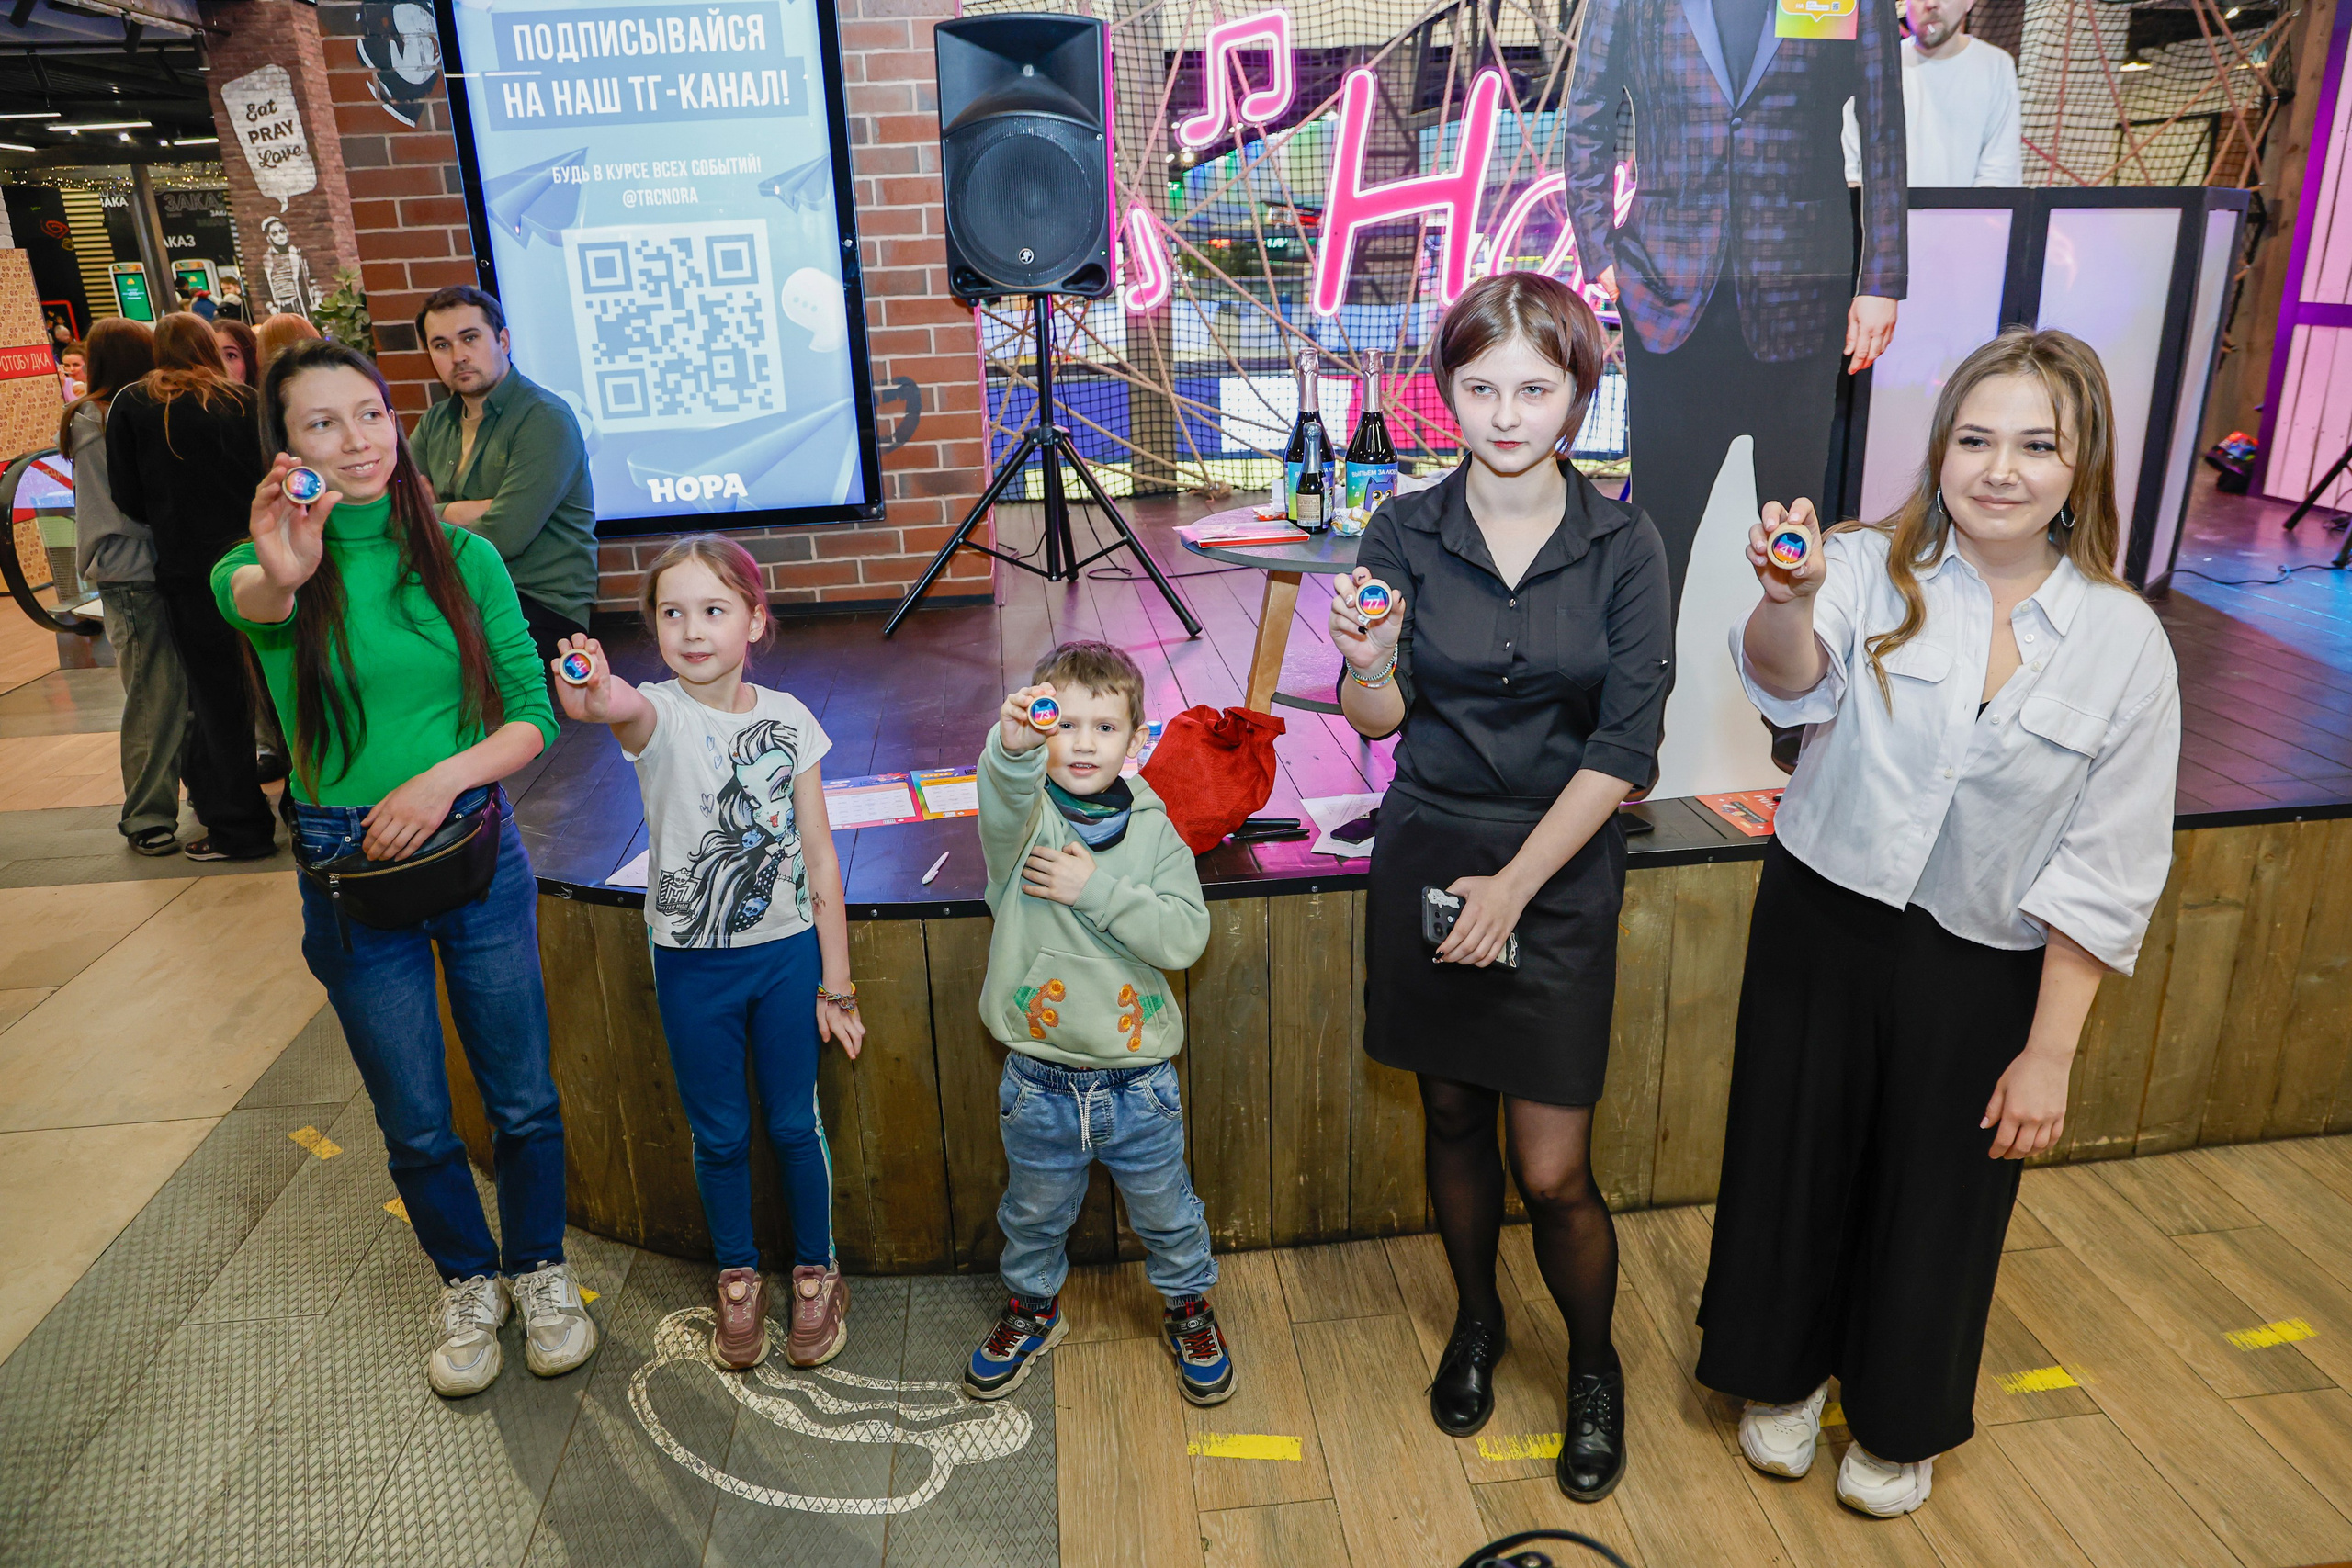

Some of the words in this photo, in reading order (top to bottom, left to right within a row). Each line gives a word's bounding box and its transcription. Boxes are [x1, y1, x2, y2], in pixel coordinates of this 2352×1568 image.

[512, 7, 766, 64] ПОДПИСЫВАЙСЯ
[503, 81, 546, 118] НА
[551, 77, 622, 116] НАШ
[245, 98, 277, 122] Eat
[247, 119, 294, 145] PRAY
[551, 165, 591, 185] БУДЬ
[593, 164, 604, 182] В
[605, 162, 650, 181] КУРСЕ
[652, 160, 689, 179] ВСЕХ
[691, 153, 763, 176] СОБЫТИЙ!
[622, 186, 699, 209] @TRCNORA
[0, 352, 51, 372] ОТОБУДКА
[1351, 469, 1377, 478] ВЫПЬЕМ
[646, 472, 749, 503] НОРА
[1779, 544, 1795, 558] 41
[1366, 598, 1380, 610] 77
[1037, 709, 1051, 721] 73
